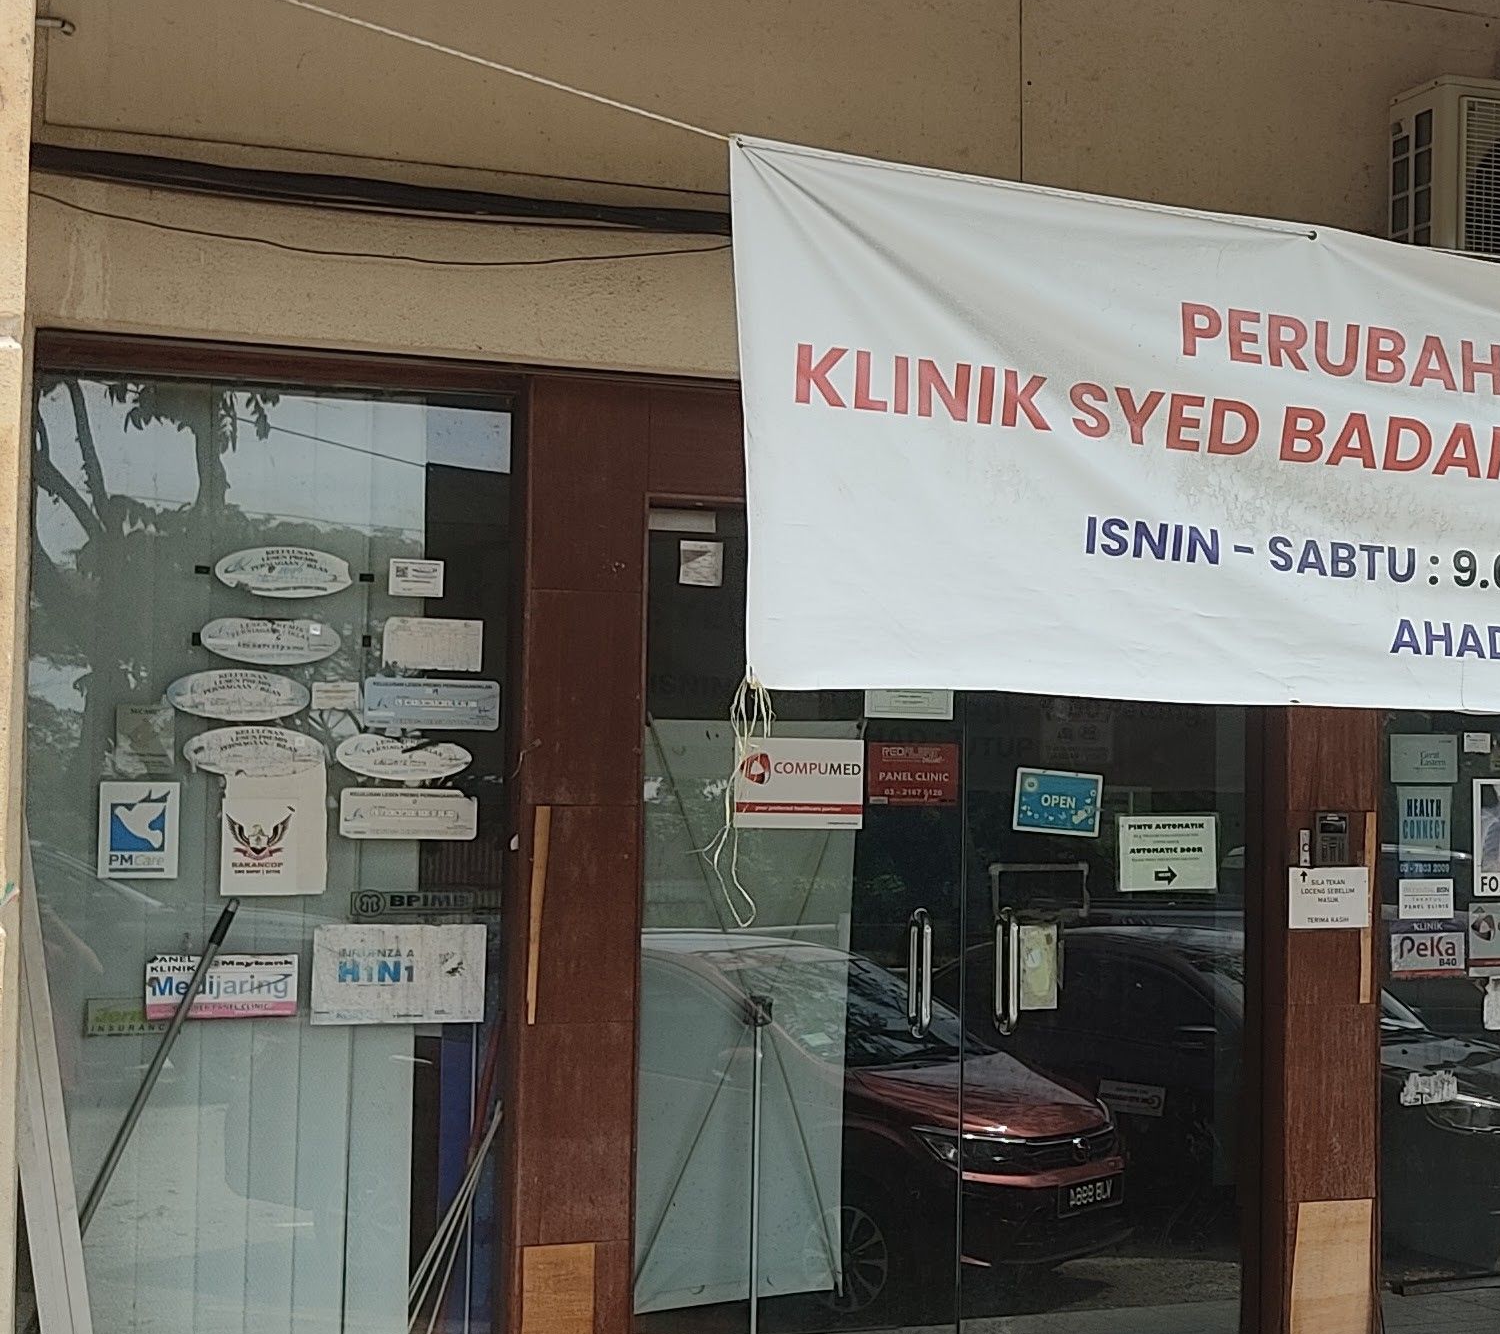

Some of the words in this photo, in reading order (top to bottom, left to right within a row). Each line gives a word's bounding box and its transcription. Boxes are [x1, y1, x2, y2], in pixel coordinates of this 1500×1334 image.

[793, 342, 1052, 433] KLINIK
[1068, 381, 1261, 459] SYED
[1084, 515, 1221, 566] ISNIN
[1268, 534, 1418, 585] SABTU
[773, 762, 861, 776] COMPUMED
[879, 772, 913, 781] PANEL
[915, 772, 949, 782] CLINIC
[1040, 794, 1076, 809] OPEN
[1406, 799, 1442, 818] HEALTH
[1128, 823, 1153, 831] PINTU
[1155, 822, 1204, 830] AUTOMATIK
[1402, 819, 1446, 840] CONNECT
[1129, 847, 1178, 855] AUTOMATIC
[1180, 846, 1203, 854] DOOR
[108, 854, 165, 867] PMCare
[1412, 922, 1443, 931] KLINIK
[1399, 935, 1456, 960] PeKa
[1439, 957, 1457, 966] B40
[150, 965, 196, 973] KLINIK
[337, 960, 414, 983] H1N1
